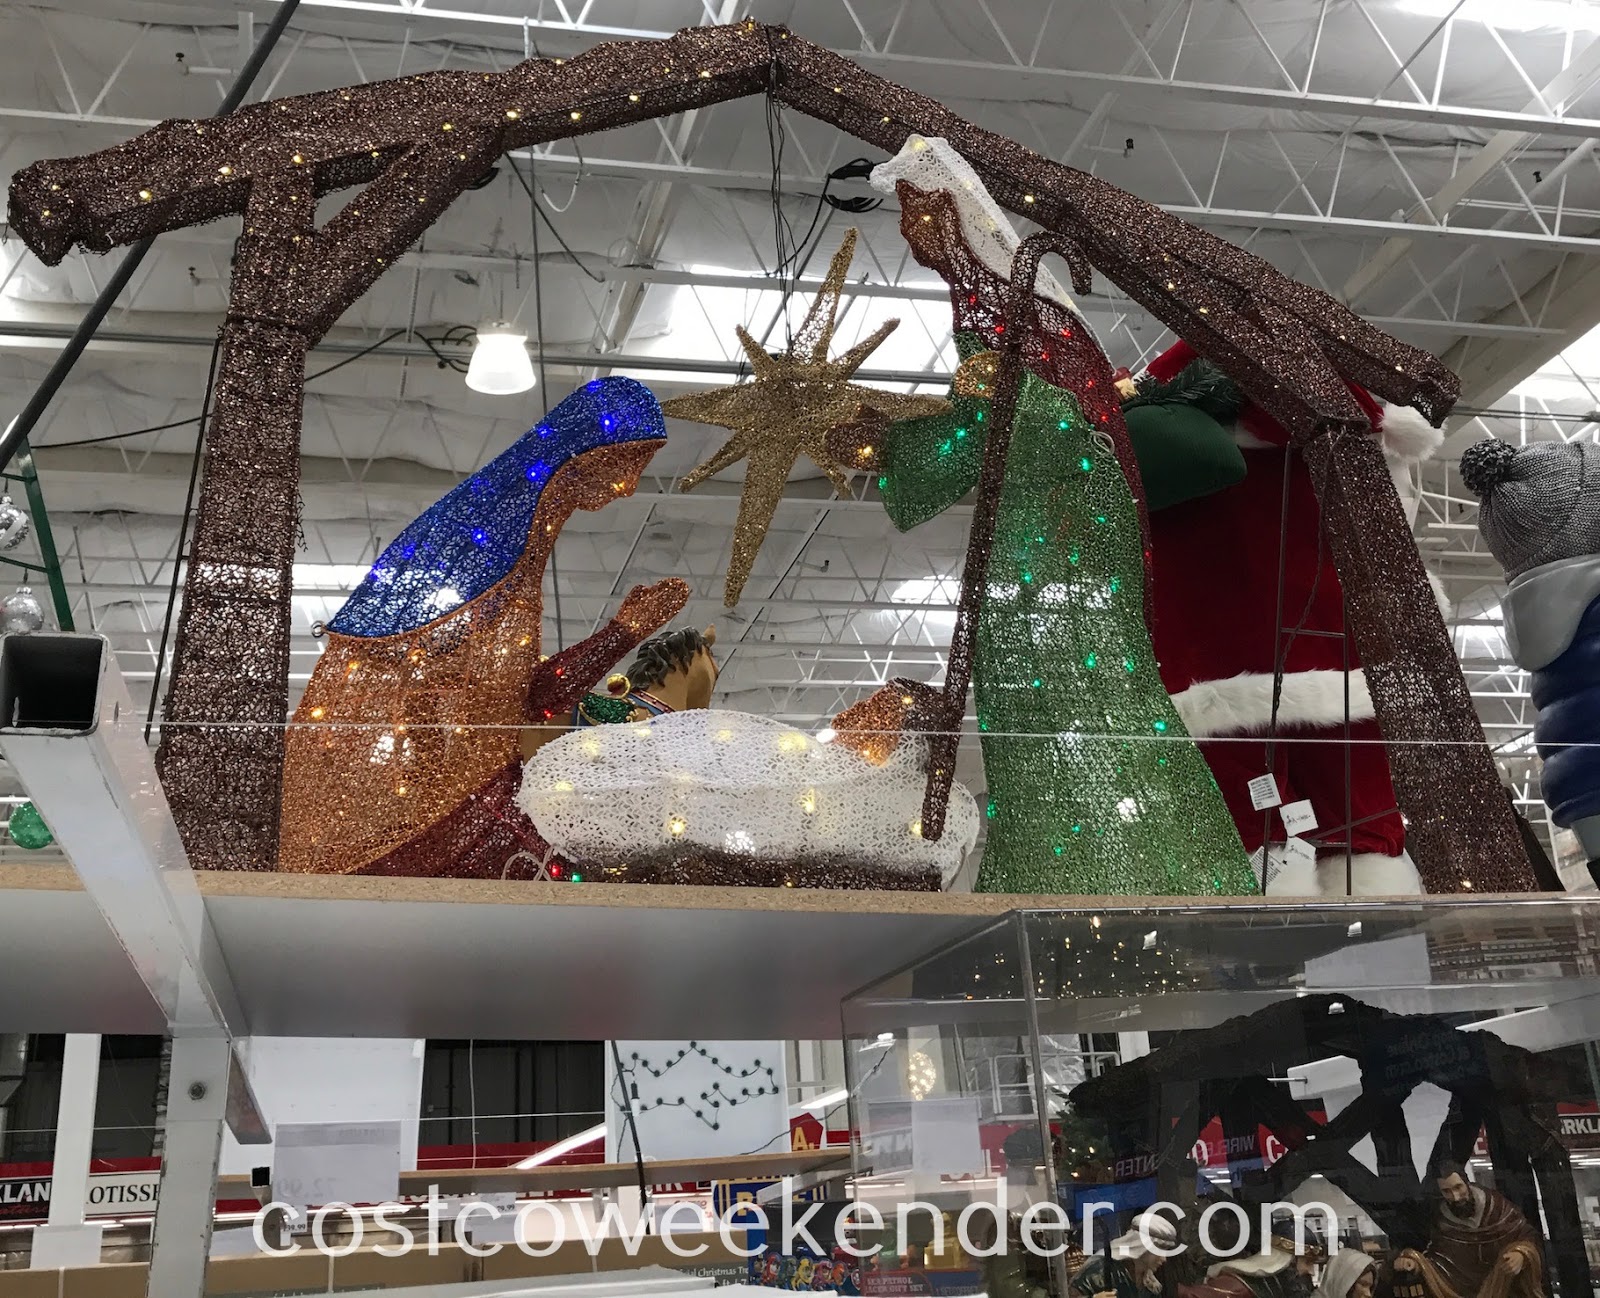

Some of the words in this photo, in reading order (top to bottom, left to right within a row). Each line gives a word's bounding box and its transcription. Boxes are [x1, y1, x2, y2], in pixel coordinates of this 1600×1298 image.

[1560, 1118, 1600, 1135] IRKL
[0, 1182, 51, 1203] LAN
[86, 1183, 159, 1204] OTISSE
[698, 1268, 736, 1277] Christmas
